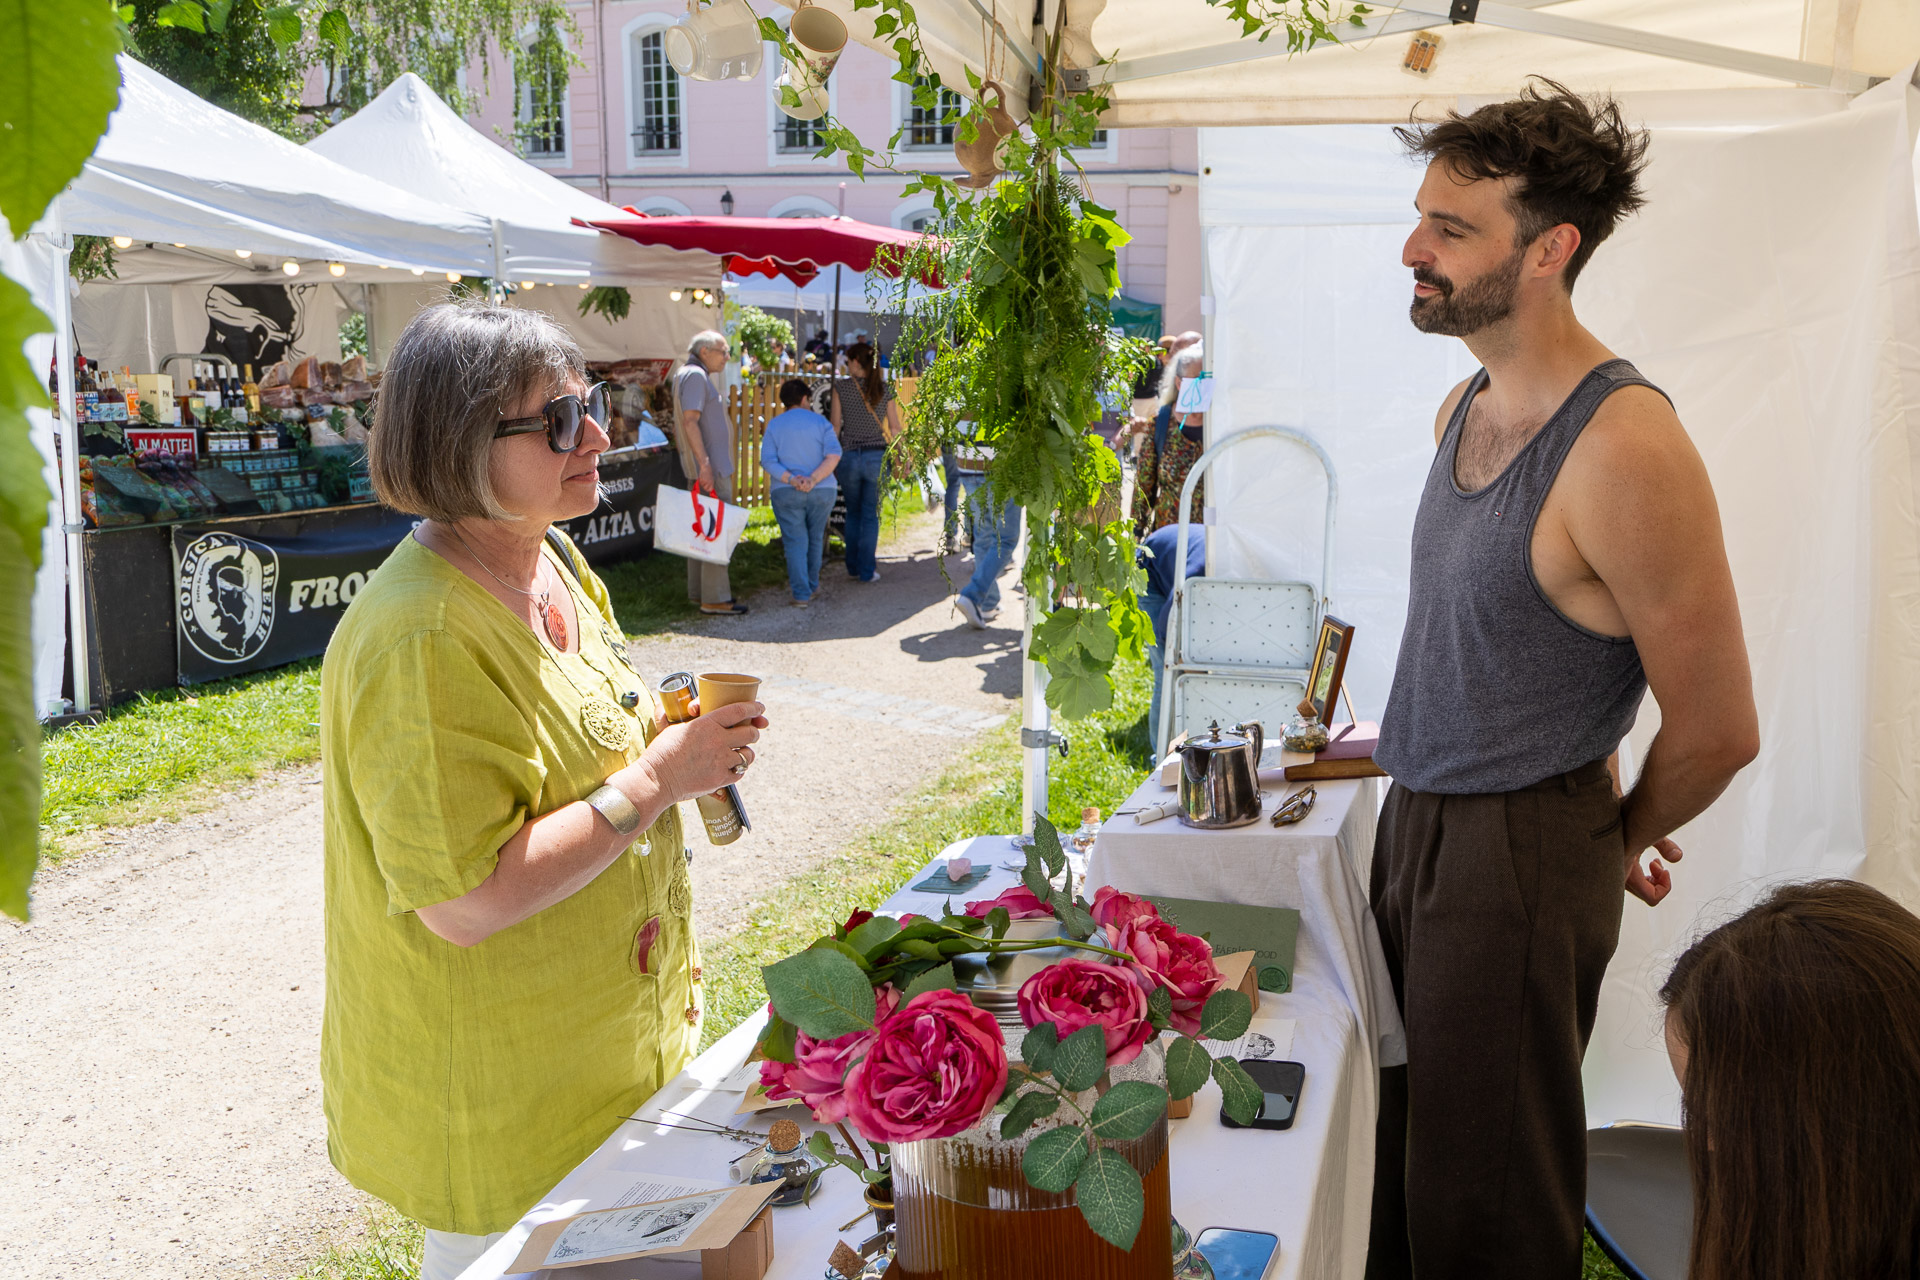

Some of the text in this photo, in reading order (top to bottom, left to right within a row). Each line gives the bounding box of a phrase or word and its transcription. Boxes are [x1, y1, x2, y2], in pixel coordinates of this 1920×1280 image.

[150, 438, 193, 453] MATTEI
[602, 477, 635, 494] ORSES
[180, 536, 224, 622] CORSICA
[288, 570, 377, 614] FRO
[583, 510, 635, 545] ALTA
[255, 561, 275, 642] BREIZH
[1249, 948, 1277, 959] OOD
